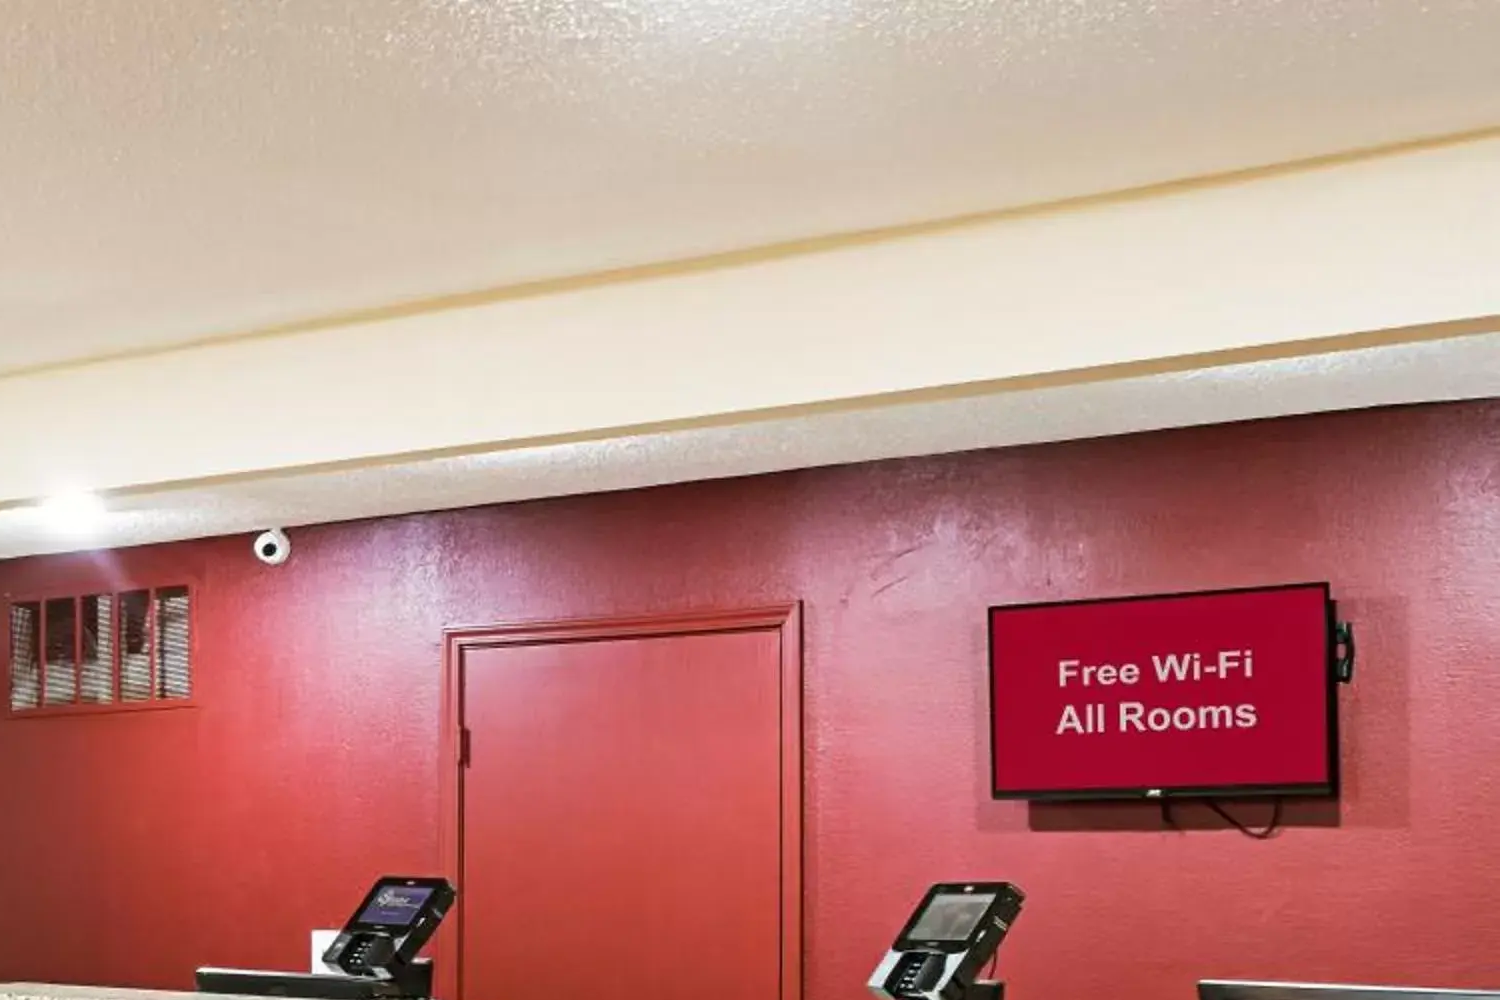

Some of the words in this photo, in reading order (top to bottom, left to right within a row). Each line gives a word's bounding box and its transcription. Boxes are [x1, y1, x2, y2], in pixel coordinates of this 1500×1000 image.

[1058, 660, 1140, 687] Free
[1152, 650, 1254, 683] Wi-Fi
[1055, 704, 1105, 735] All
[1119, 702, 1258, 732] Rooms
